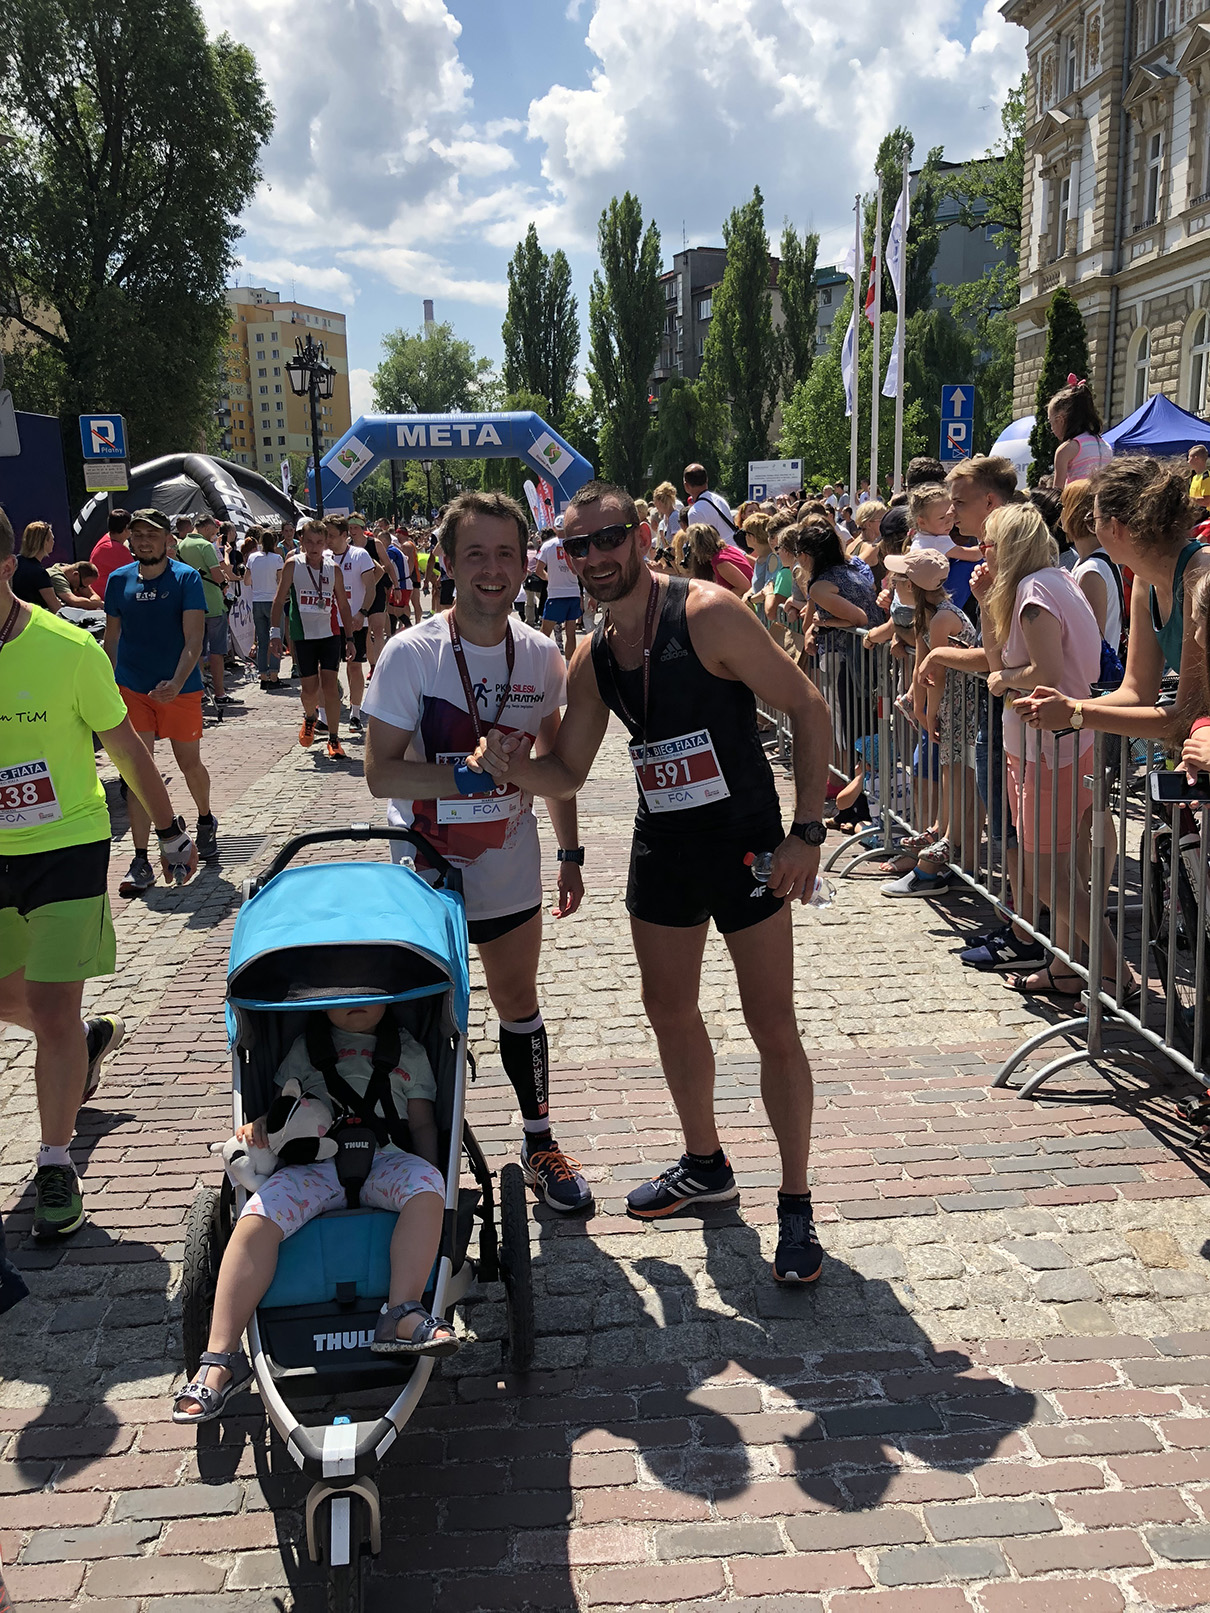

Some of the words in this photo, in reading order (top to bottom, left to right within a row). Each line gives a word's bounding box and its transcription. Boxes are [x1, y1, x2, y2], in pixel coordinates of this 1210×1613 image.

[90, 420, 115, 453] P
[396, 424, 502, 447] META
[947, 423, 966, 448] P
[753, 486, 763, 500] P
[16, 710, 48, 723] TiM
[653, 743, 674, 756] BIEG
[675, 735, 705, 751] FIATA
[11, 763, 43, 778] FIATA
[654, 759, 692, 787] 591
[667, 791, 694, 803] FCA
[473, 804, 501, 815] FCA
[344, 1141, 370, 1149] THULE
